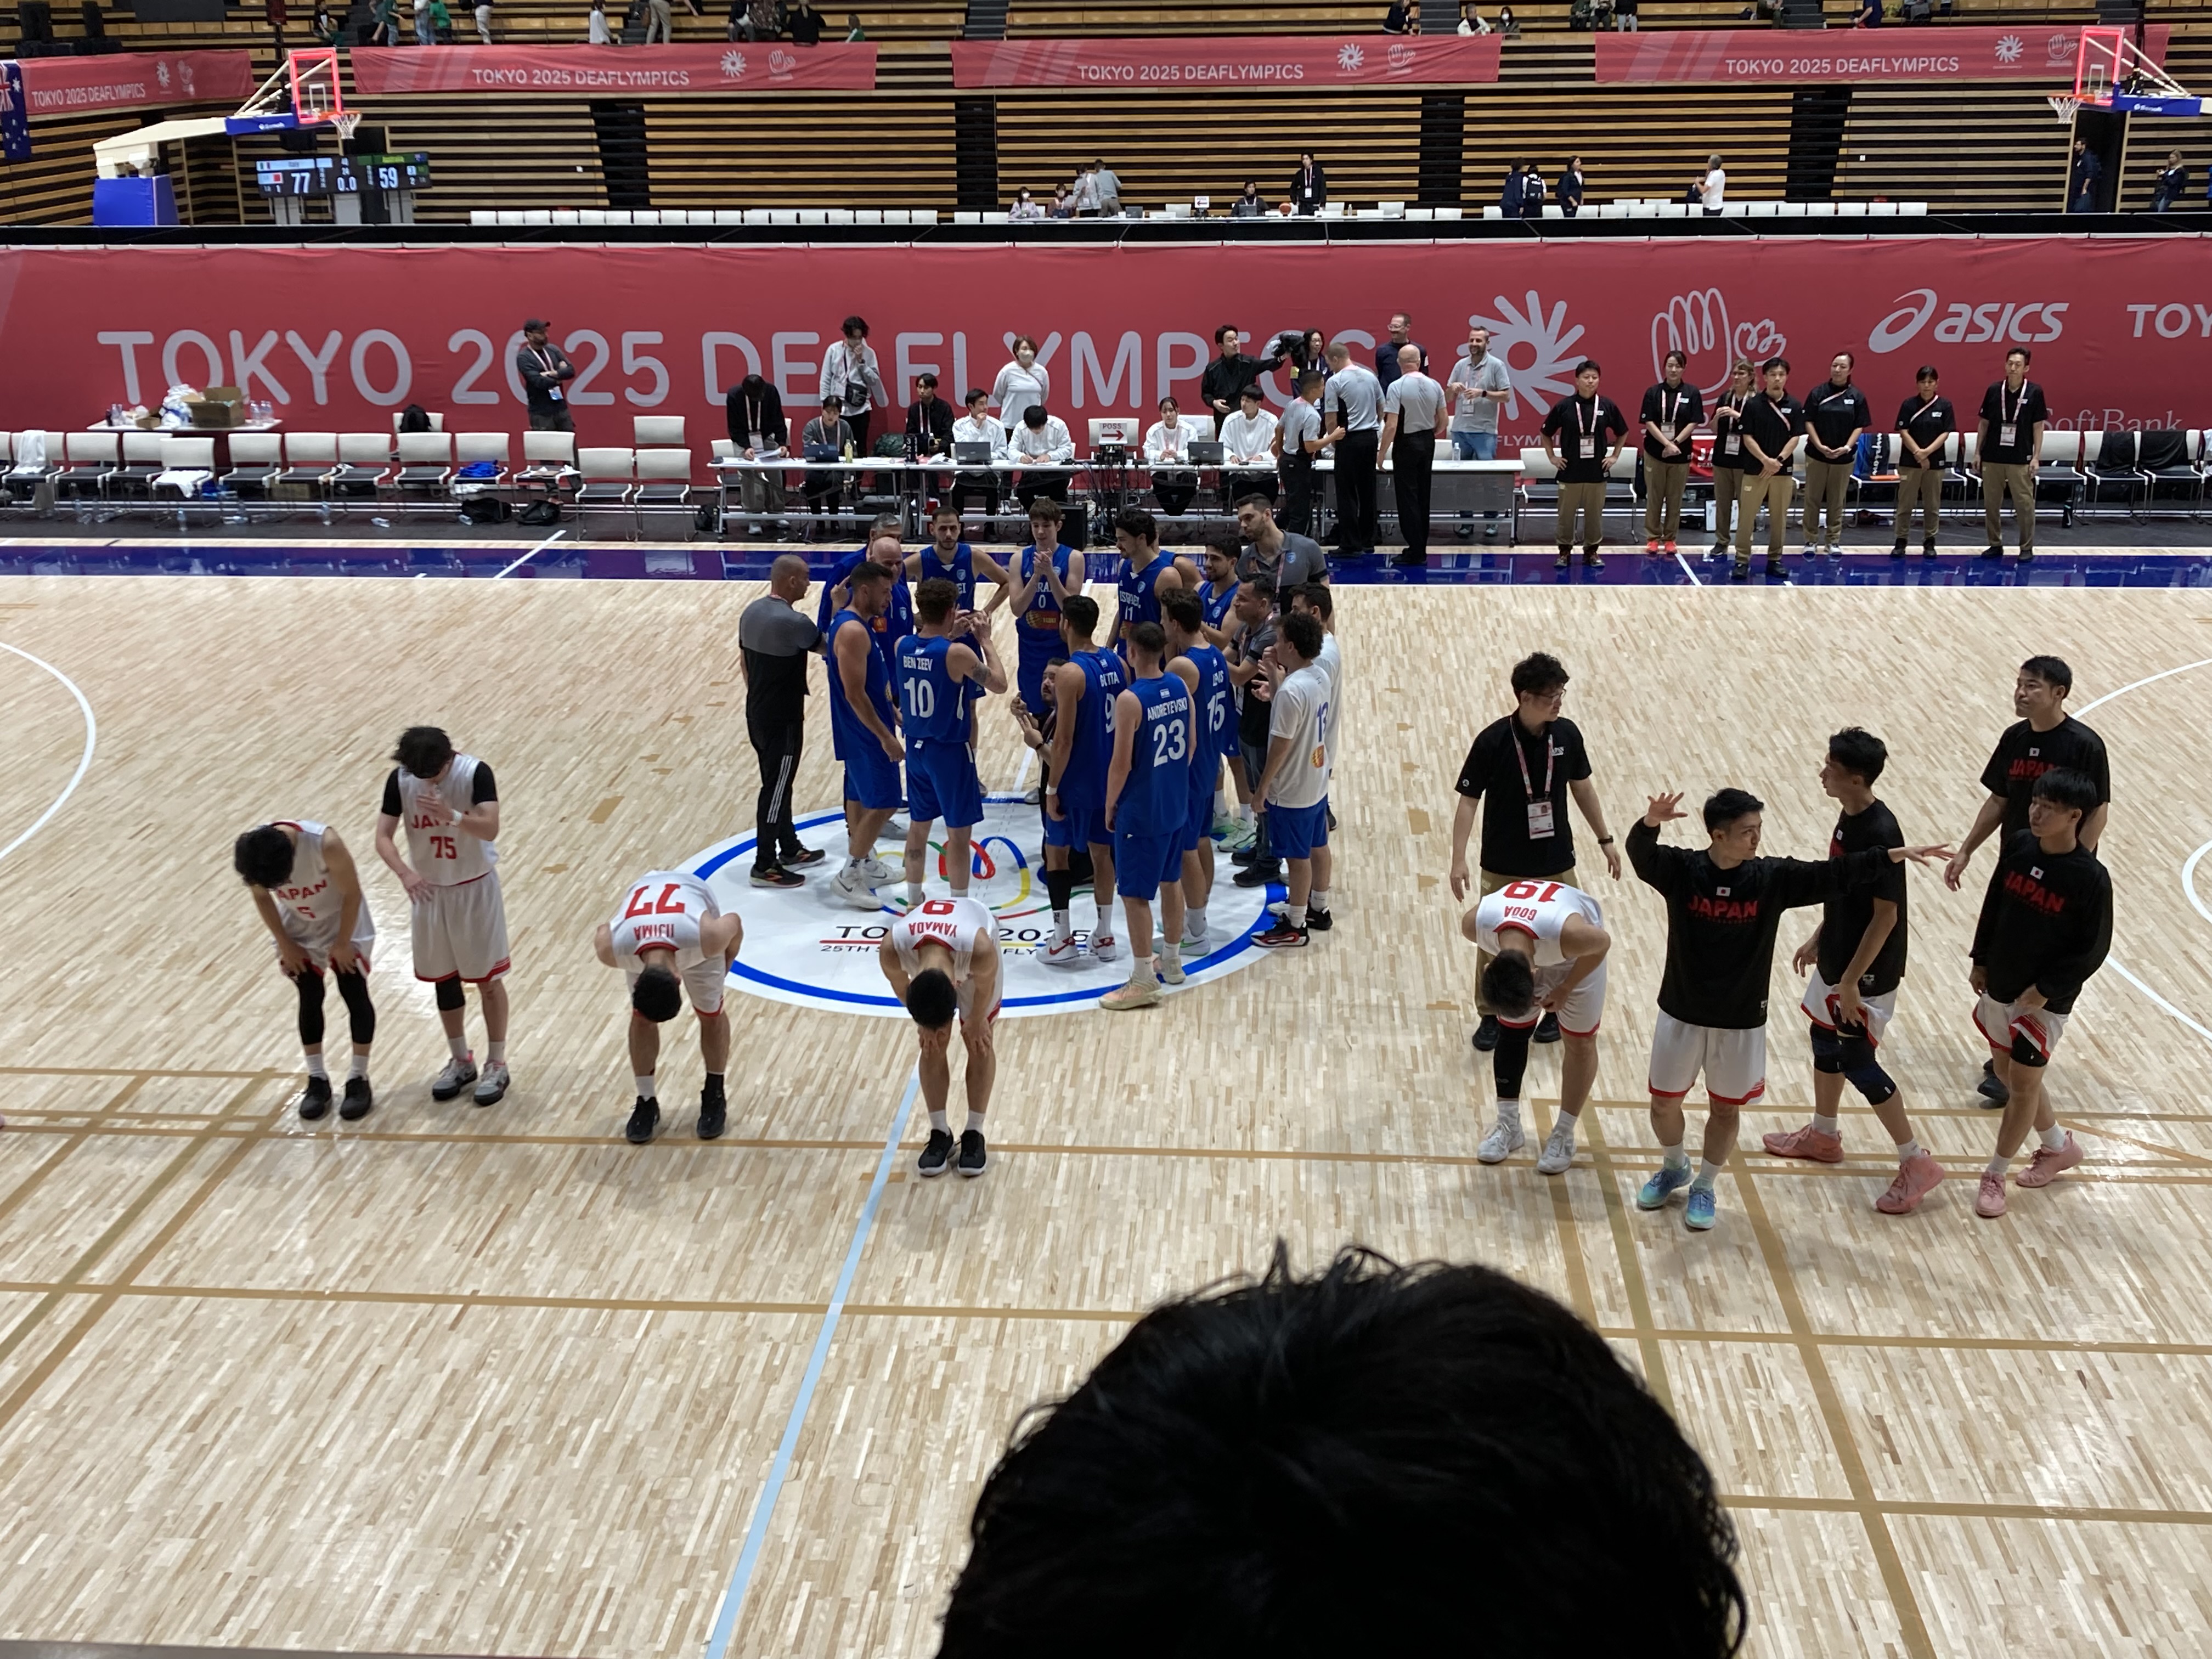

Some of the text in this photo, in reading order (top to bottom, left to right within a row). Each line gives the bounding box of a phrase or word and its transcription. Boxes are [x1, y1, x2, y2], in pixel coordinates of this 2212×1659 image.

[1077, 64, 1304, 80] TOKYO 2025 DEAFLYMPICS
[1725, 57, 1959, 74] TOKYO 2025 DEAFLYMPICS
[472, 69, 690, 86] TOKYO 2025 DEAFLYMPICS
[31, 83, 146, 107] TOKYO 2025 DEAFLYMPICS
[290, 172, 311, 194] 77
[337, 176, 357, 191] 0.0
[378, 167, 399, 189] 59
[97, 329, 413, 406] TOKYO
[1038, 594, 1046, 608] 0
[1125, 605, 1133, 621] 11
[903, 656, 933, 672] BEN ZEEV
[904, 677, 934, 718] 10
[1207, 690, 1226, 735] 15
[1153, 719, 1186, 768] 23
[430, 836, 458, 860] 75
[277, 879, 327, 900] APAN
[1503, 879, 1565, 902] 19
[2004, 870, 2066, 912] JAPAN
[625, 883, 685, 920] 77
[1687, 895, 1758, 919] JAPAN
[1504, 906, 1538, 921] GODA
[908, 921, 957, 938] YAMADA
